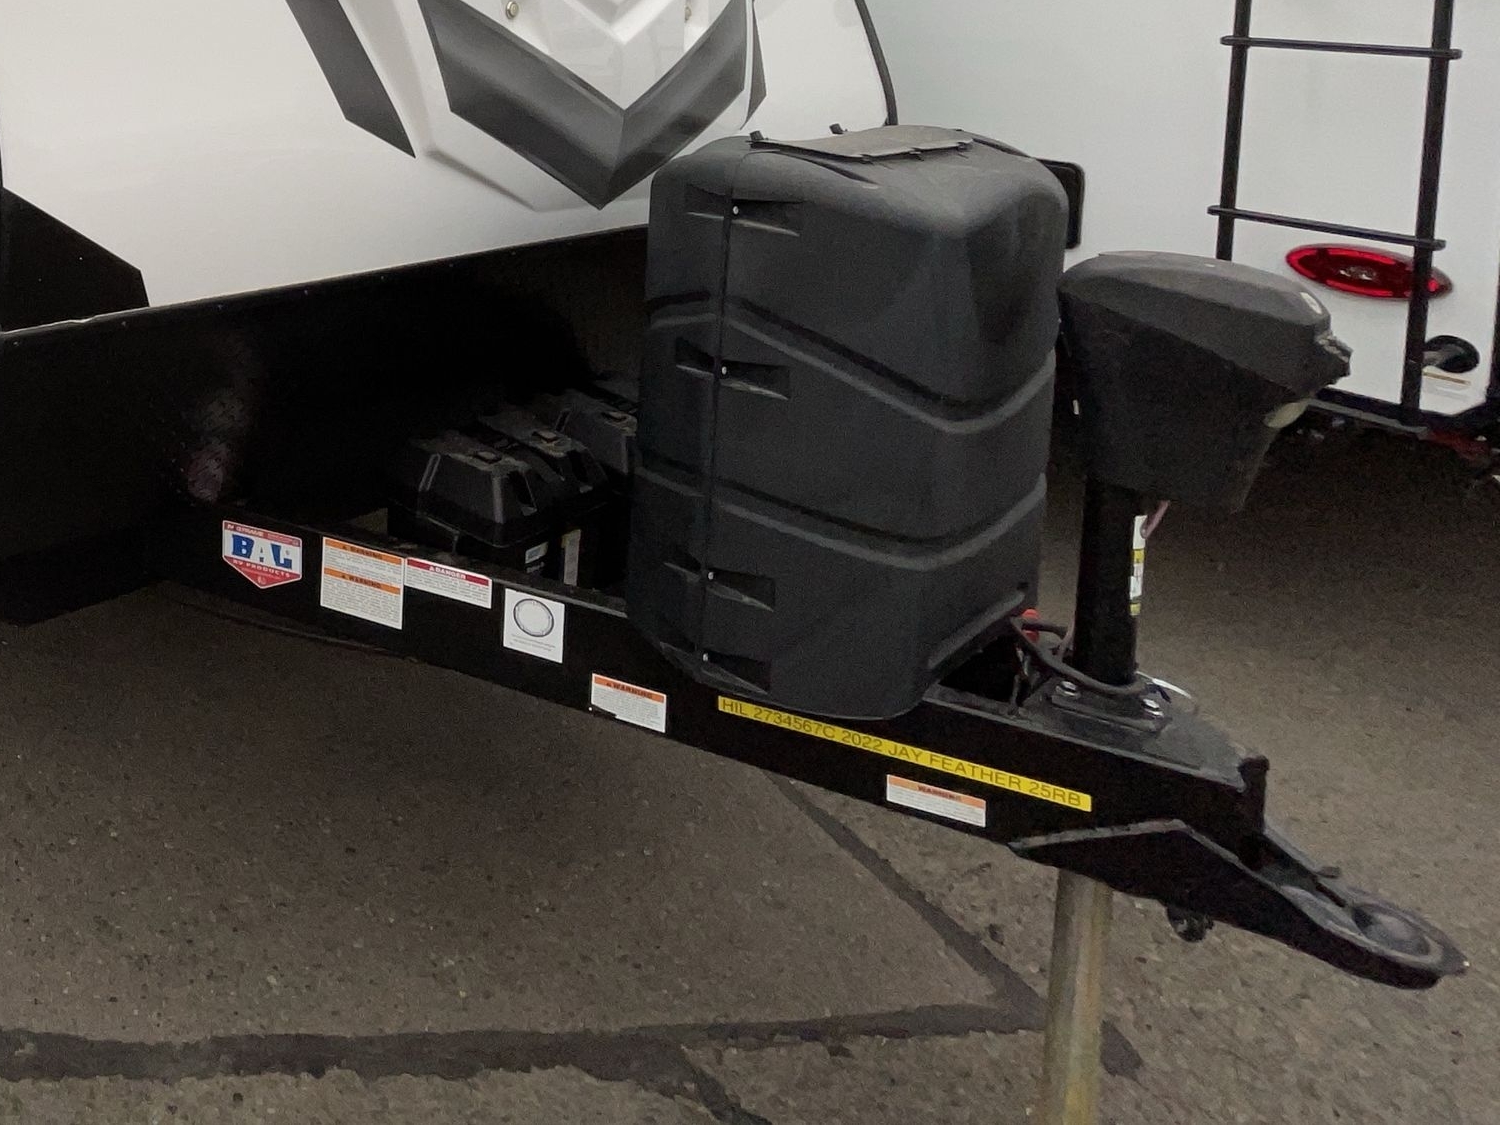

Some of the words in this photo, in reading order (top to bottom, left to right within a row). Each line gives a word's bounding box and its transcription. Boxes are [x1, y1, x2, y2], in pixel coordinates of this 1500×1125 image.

[231, 533, 293, 569] BAL
[246, 561, 290, 578] PRODUCTS
[436, 567, 467, 580] DANGER
[349, 575, 382, 589] WARNING
[722, 699, 748, 715] HIL
[753, 707, 836, 739] 2734567C
[841, 730, 883, 752] 2022
[888, 744, 924, 763] JAY
[929, 755, 1022, 790] FEATHER
[1029, 781, 1082, 807] 25RB
